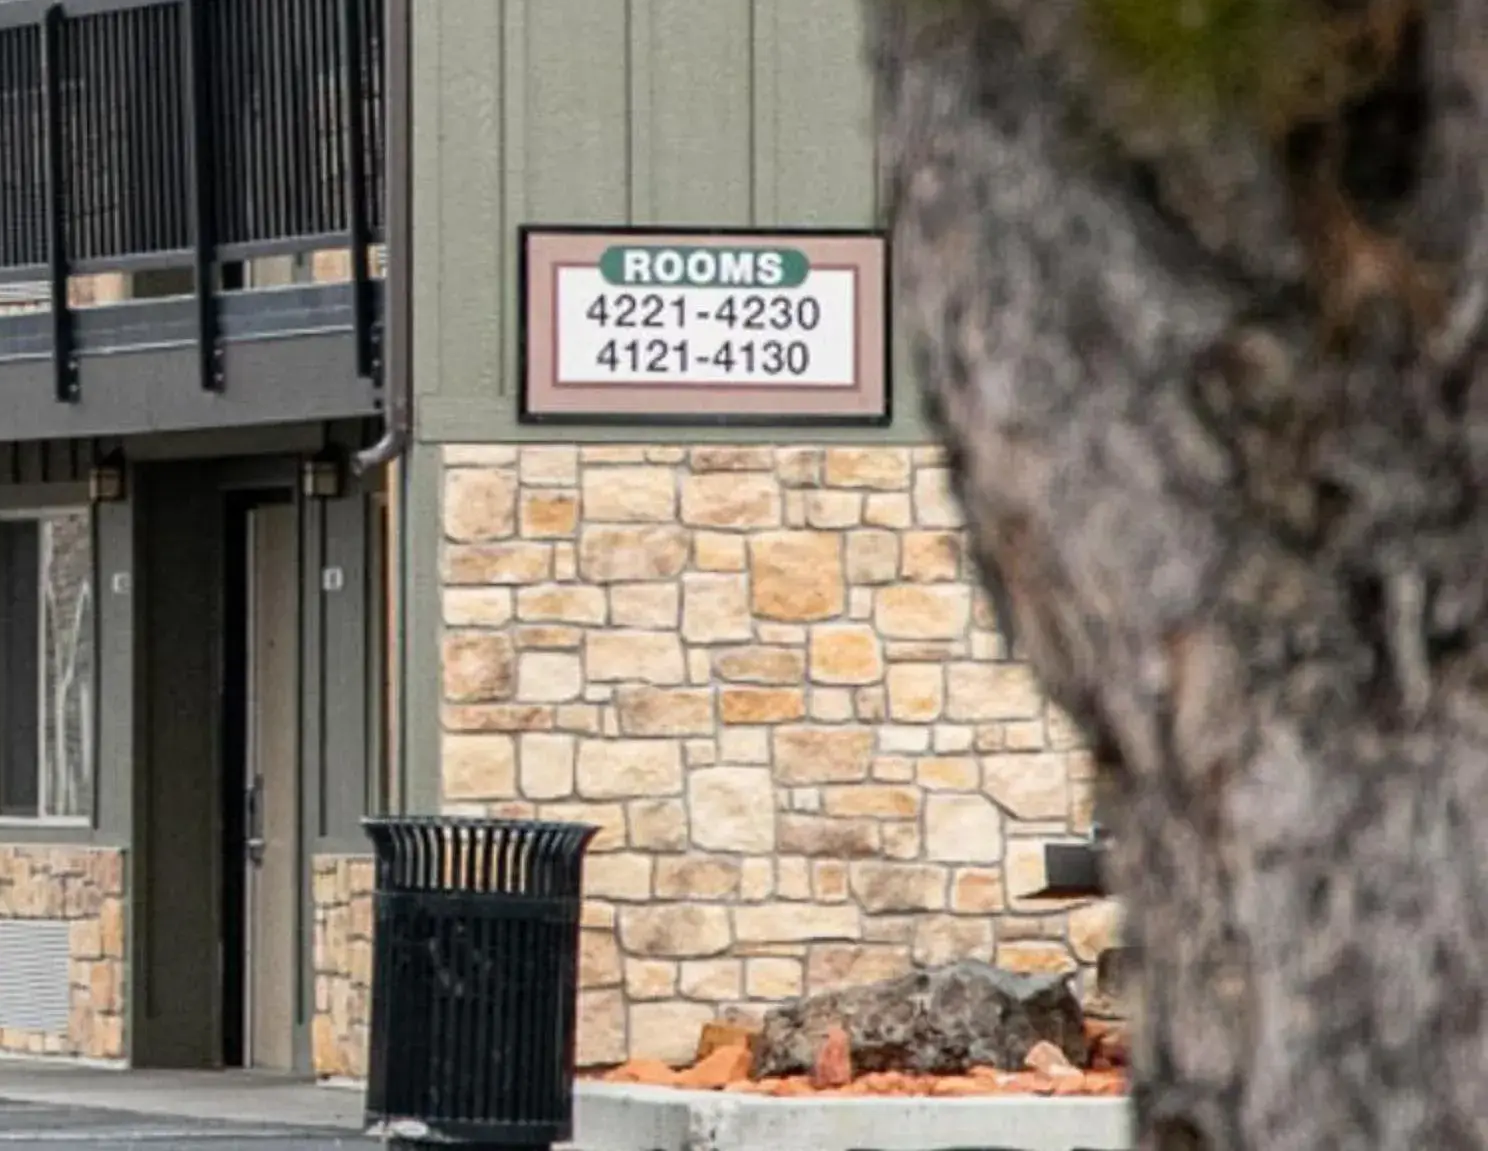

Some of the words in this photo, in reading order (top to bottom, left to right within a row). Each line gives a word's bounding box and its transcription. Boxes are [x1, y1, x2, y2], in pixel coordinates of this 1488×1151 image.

[623, 249, 783, 284] ROOMS
[586, 293, 821, 331] 4221-4230
[596, 338, 810, 375] 4121-4130
